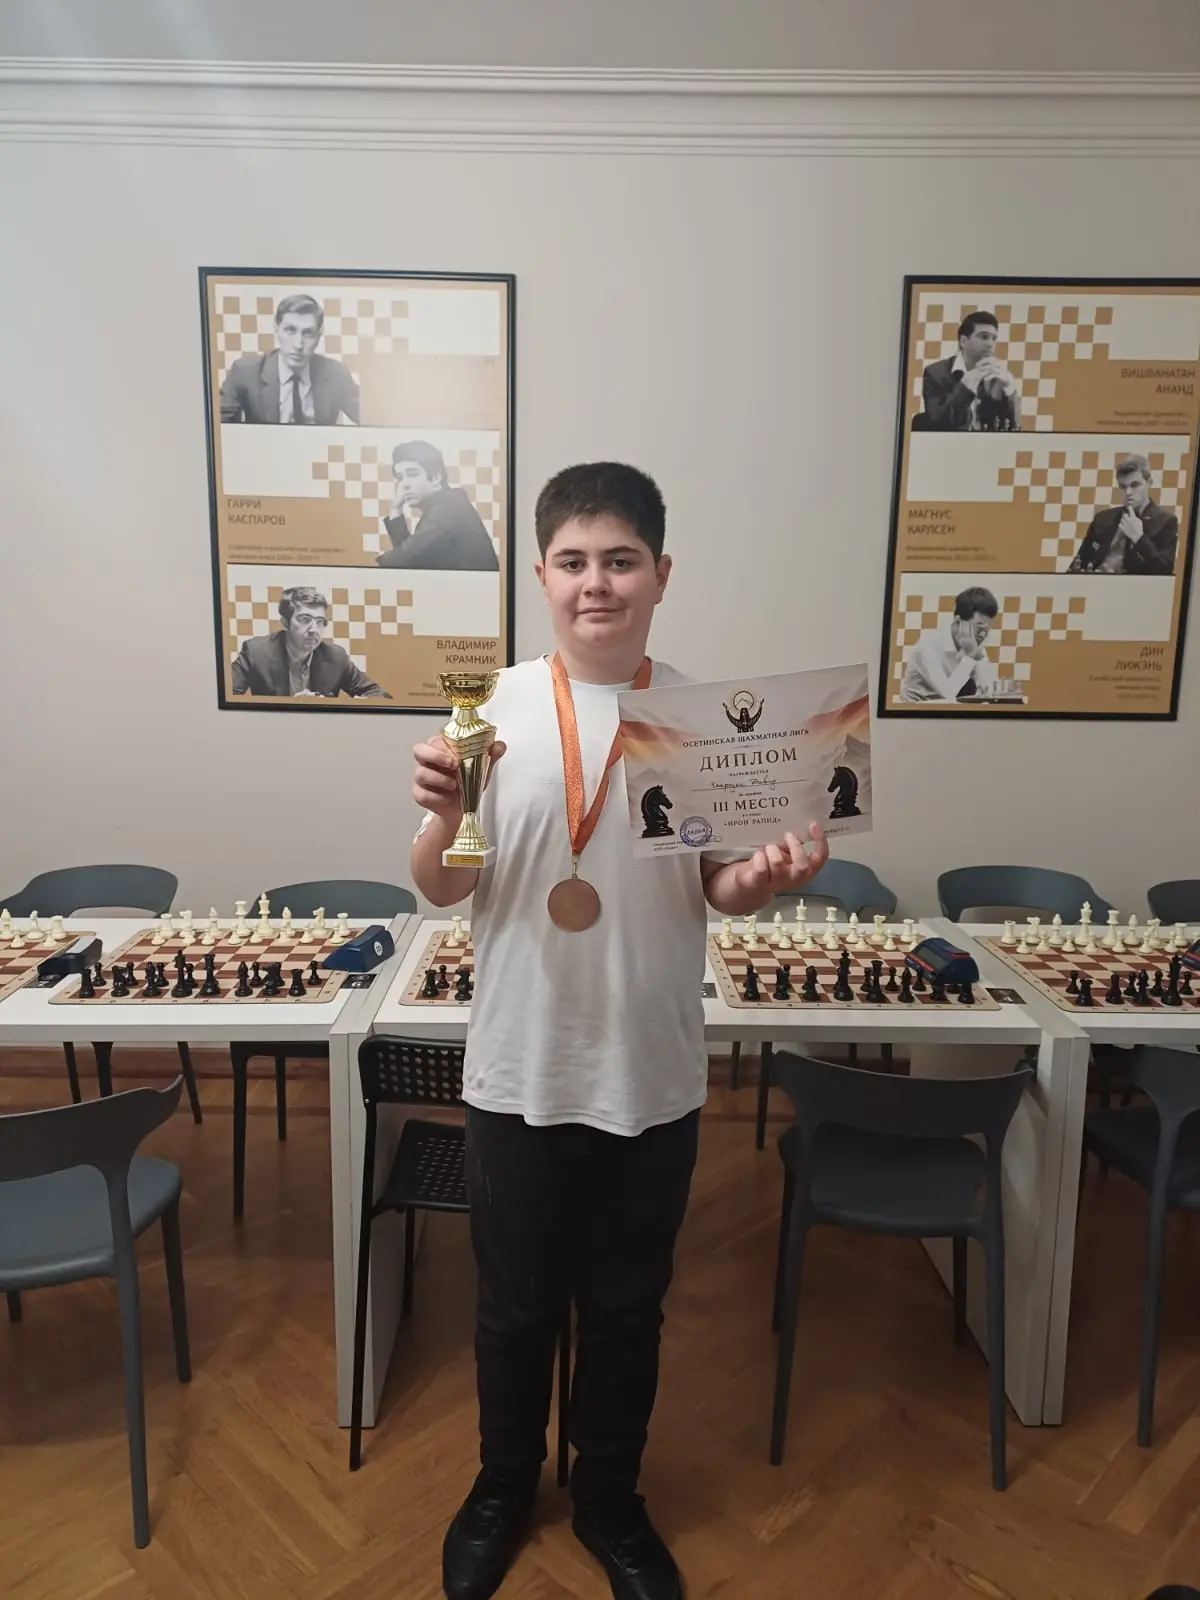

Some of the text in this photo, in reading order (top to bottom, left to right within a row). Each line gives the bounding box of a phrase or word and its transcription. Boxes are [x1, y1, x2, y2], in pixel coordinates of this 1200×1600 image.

[1155, 384, 1194, 397] АНАНД
[227, 499, 261, 509] ГАРРИ
[908, 508, 952, 519] МАГНУС
[227, 514, 286, 525] КАСПАРОВ
[907, 524, 955, 535] КАРЛСЕН
[437, 639, 496, 651] ВЛАДИМИР
[1140, 646, 1164, 657] ДИН
[445, 655, 496, 664] КРАМНИК
[682, 729, 809, 748] ОСЕТИНСКАЯ ШАХМАТНАЯ ЛИГА
[700, 747, 797, 772] ДИПЛОМ
[713, 796, 789, 812] III МЕСТО
